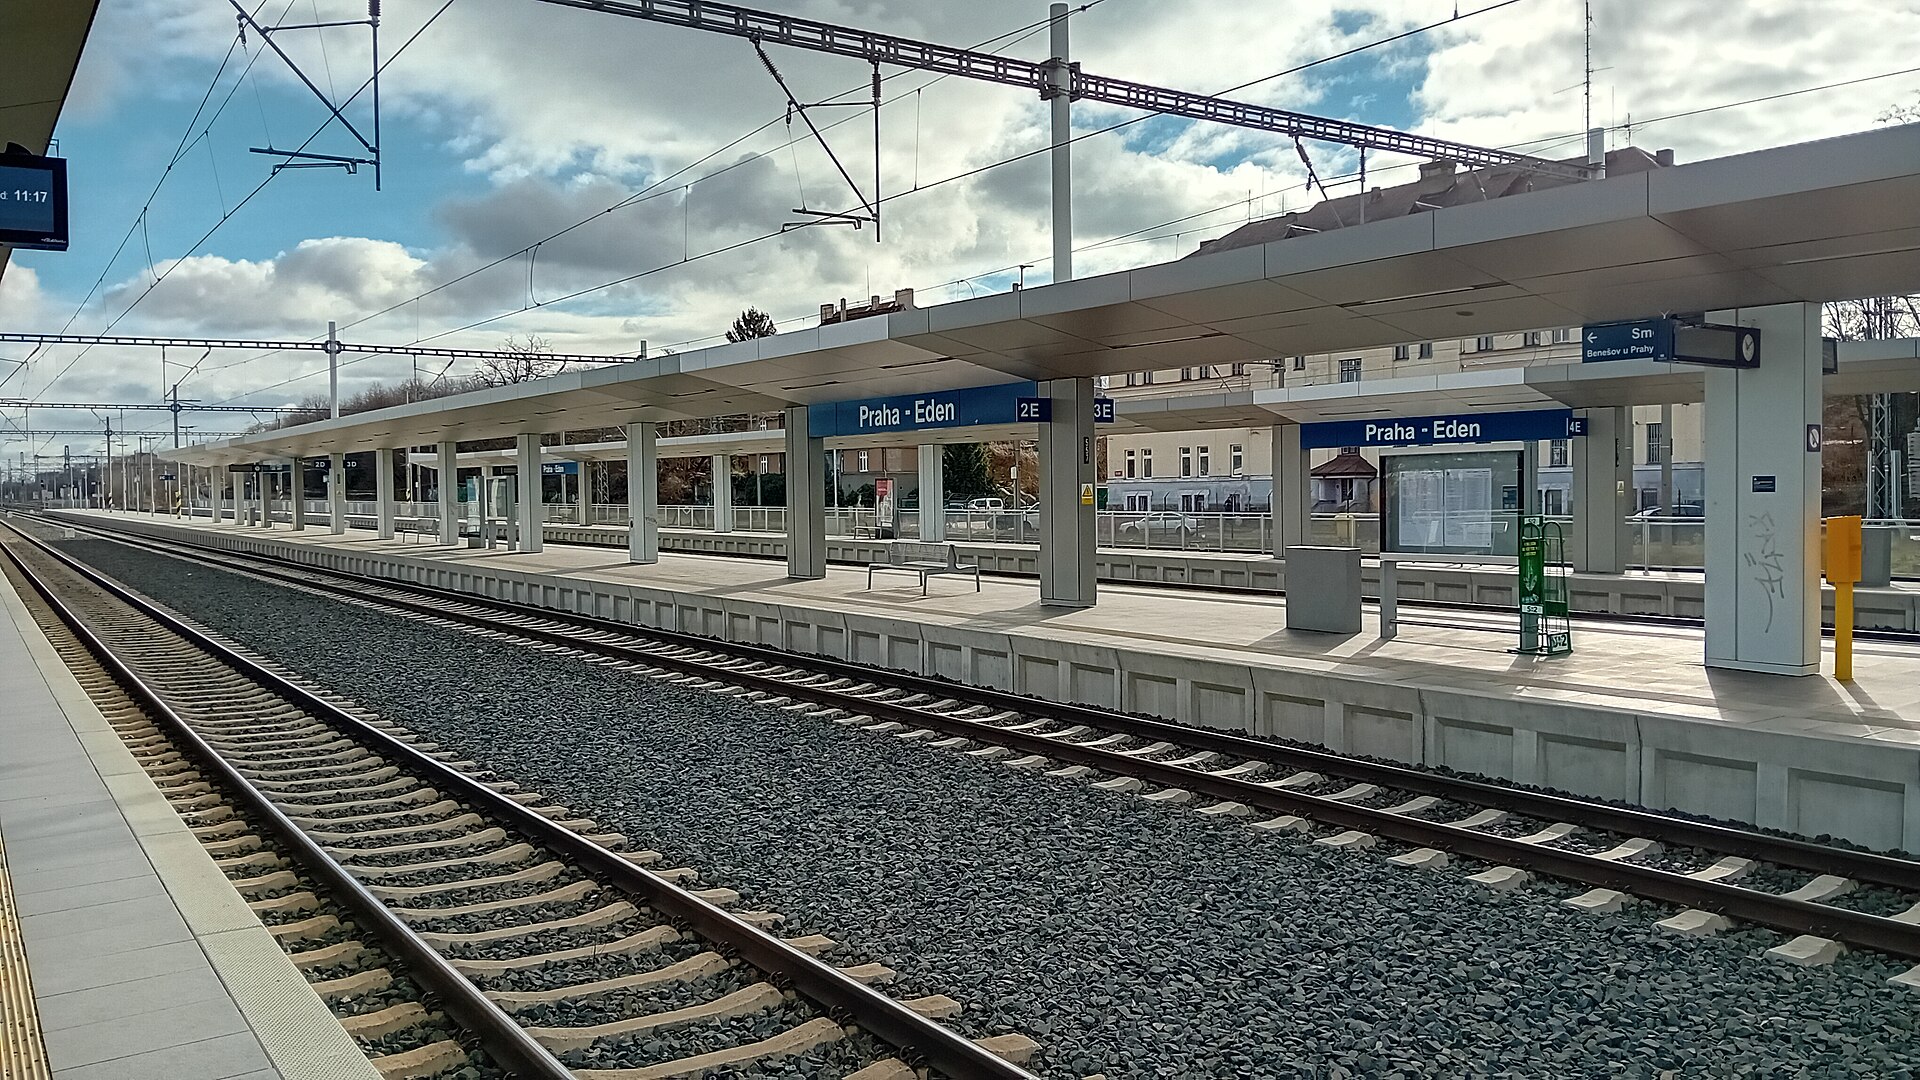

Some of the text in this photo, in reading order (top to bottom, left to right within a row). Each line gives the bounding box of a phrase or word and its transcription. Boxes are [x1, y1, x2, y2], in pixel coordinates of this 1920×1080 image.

[14, 189, 48, 202] 11:17
[1632, 327, 1655, 339] Sm
[1586, 344, 1654, 358] Benešov u Prahy
[859, 403, 900, 428] Praha
[914, 398, 955, 424] Eden
[1020, 403, 1039, 417] 2E
[1094, 403, 1112, 418] 3E
[1365, 422, 1415, 442] Praha
[1433, 419, 1481, 439] Eden
[1569, 421, 1581, 433] 4E
